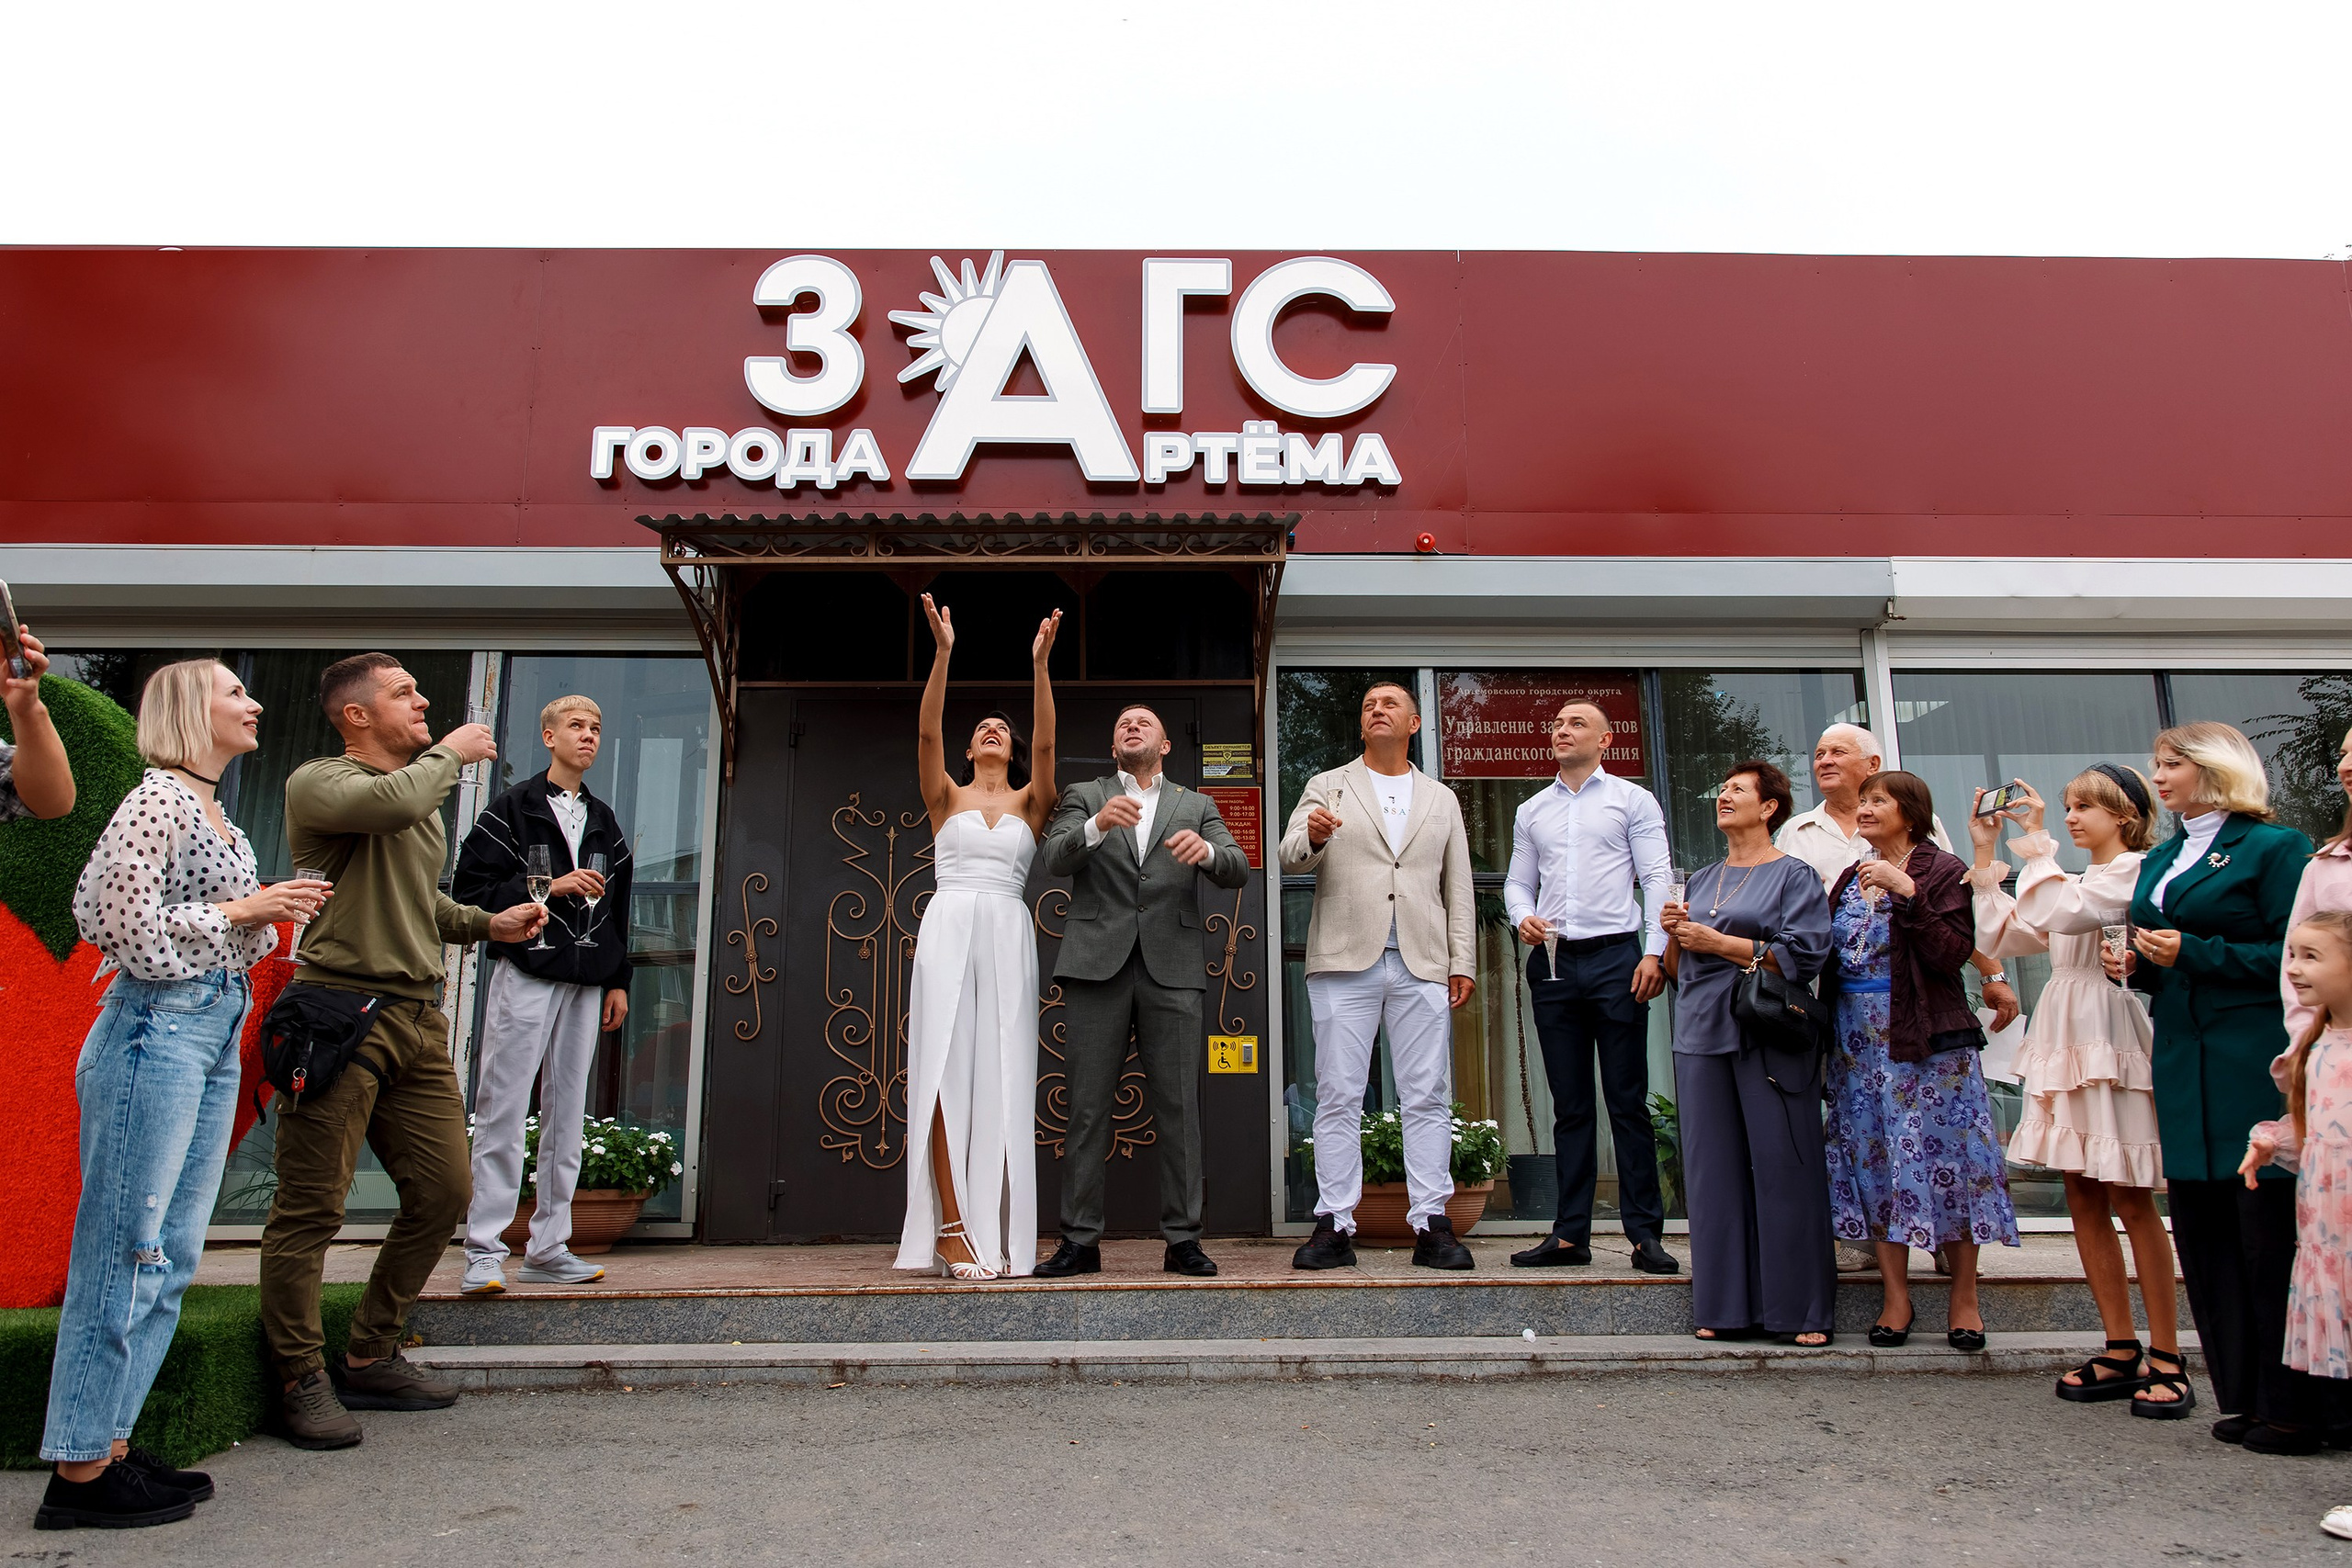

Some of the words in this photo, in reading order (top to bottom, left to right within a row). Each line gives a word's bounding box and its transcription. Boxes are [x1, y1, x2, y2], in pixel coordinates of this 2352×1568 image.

[591, 425, 890, 490] ГОРОДА
[1529, 688, 1584, 697] городского
[1587, 688, 1621, 697] округа
[1444, 716, 1534, 739] Управление
[1446, 746, 1555, 766] гражданского
